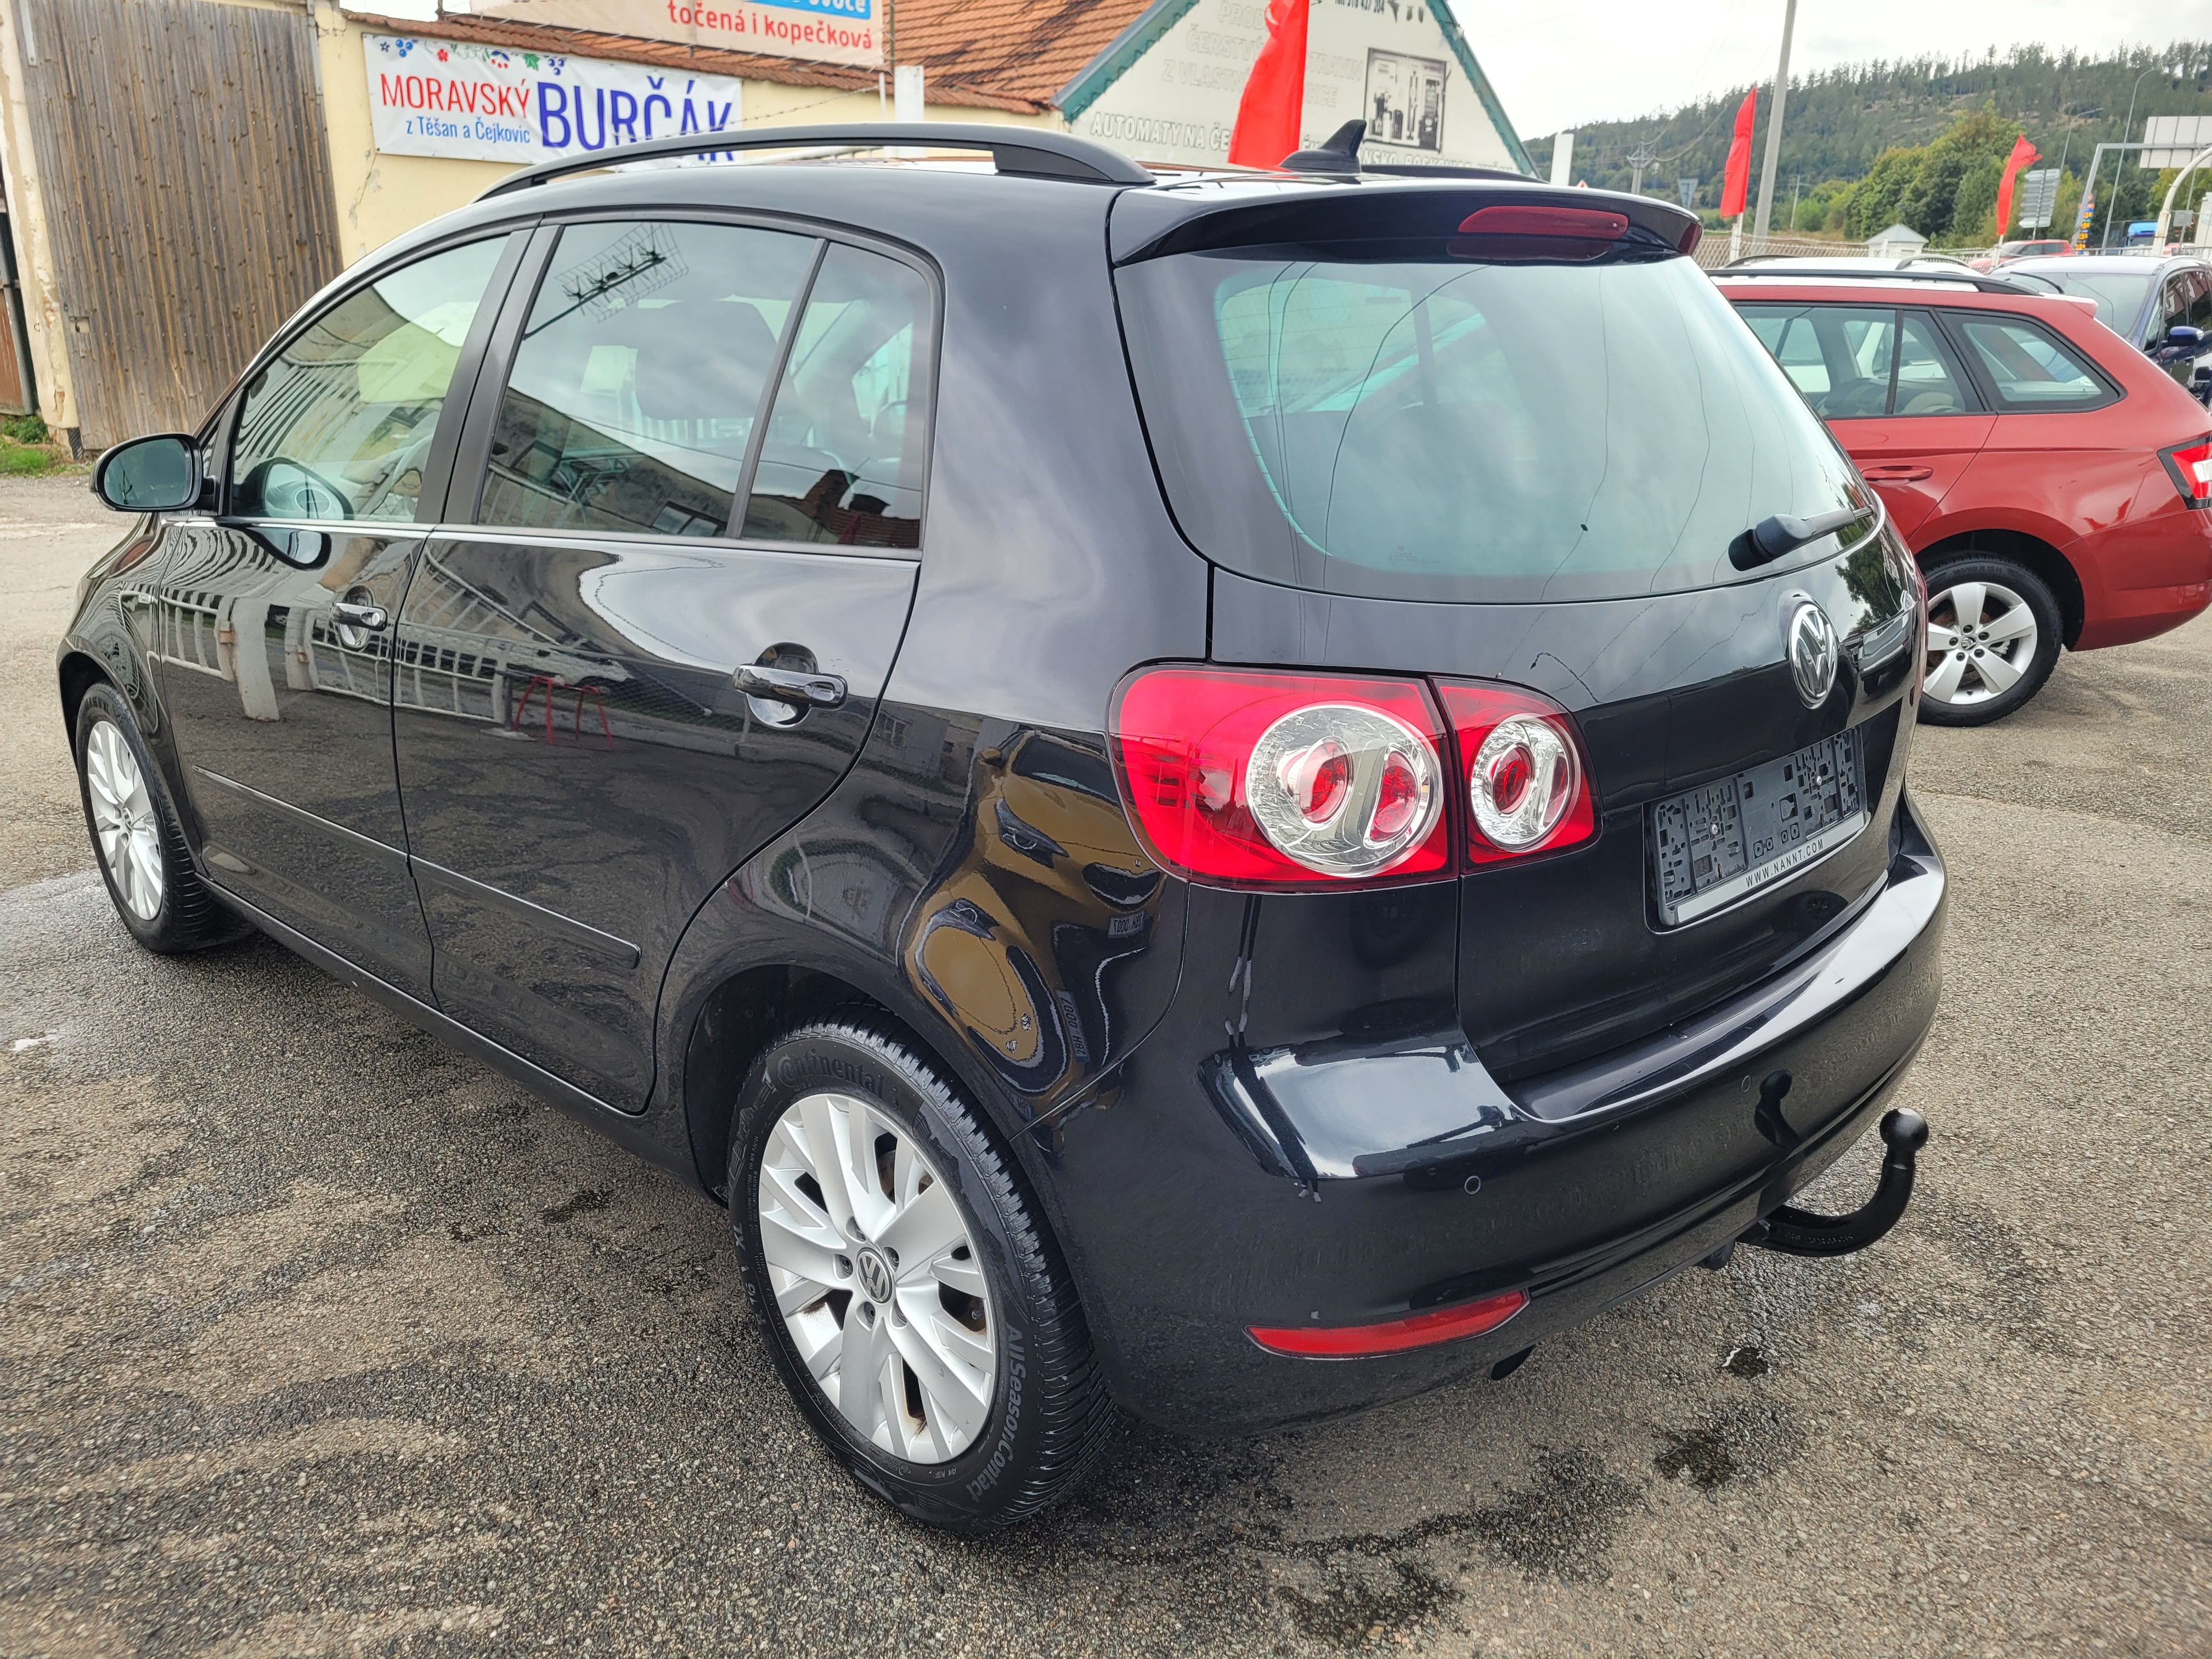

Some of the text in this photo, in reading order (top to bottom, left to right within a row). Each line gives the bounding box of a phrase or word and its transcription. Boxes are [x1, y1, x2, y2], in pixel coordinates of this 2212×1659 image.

[667, 2, 872, 49] točená i kopečková
[380, 73, 530, 119] MORAVSKÝ
[538, 75, 732, 161] BURČÁK
[406, 116, 531, 144] z Těšan a Čejkovic
[1090, 111, 1181, 146] AUTOMATY
[1183, 123, 1205, 150] NA
[1745, 838, 1824, 888] WWW.NANNT.COM
[778, 1048, 885, 1103] Continental
[966, 1322, 1026, 1502] AllSeasonContact
